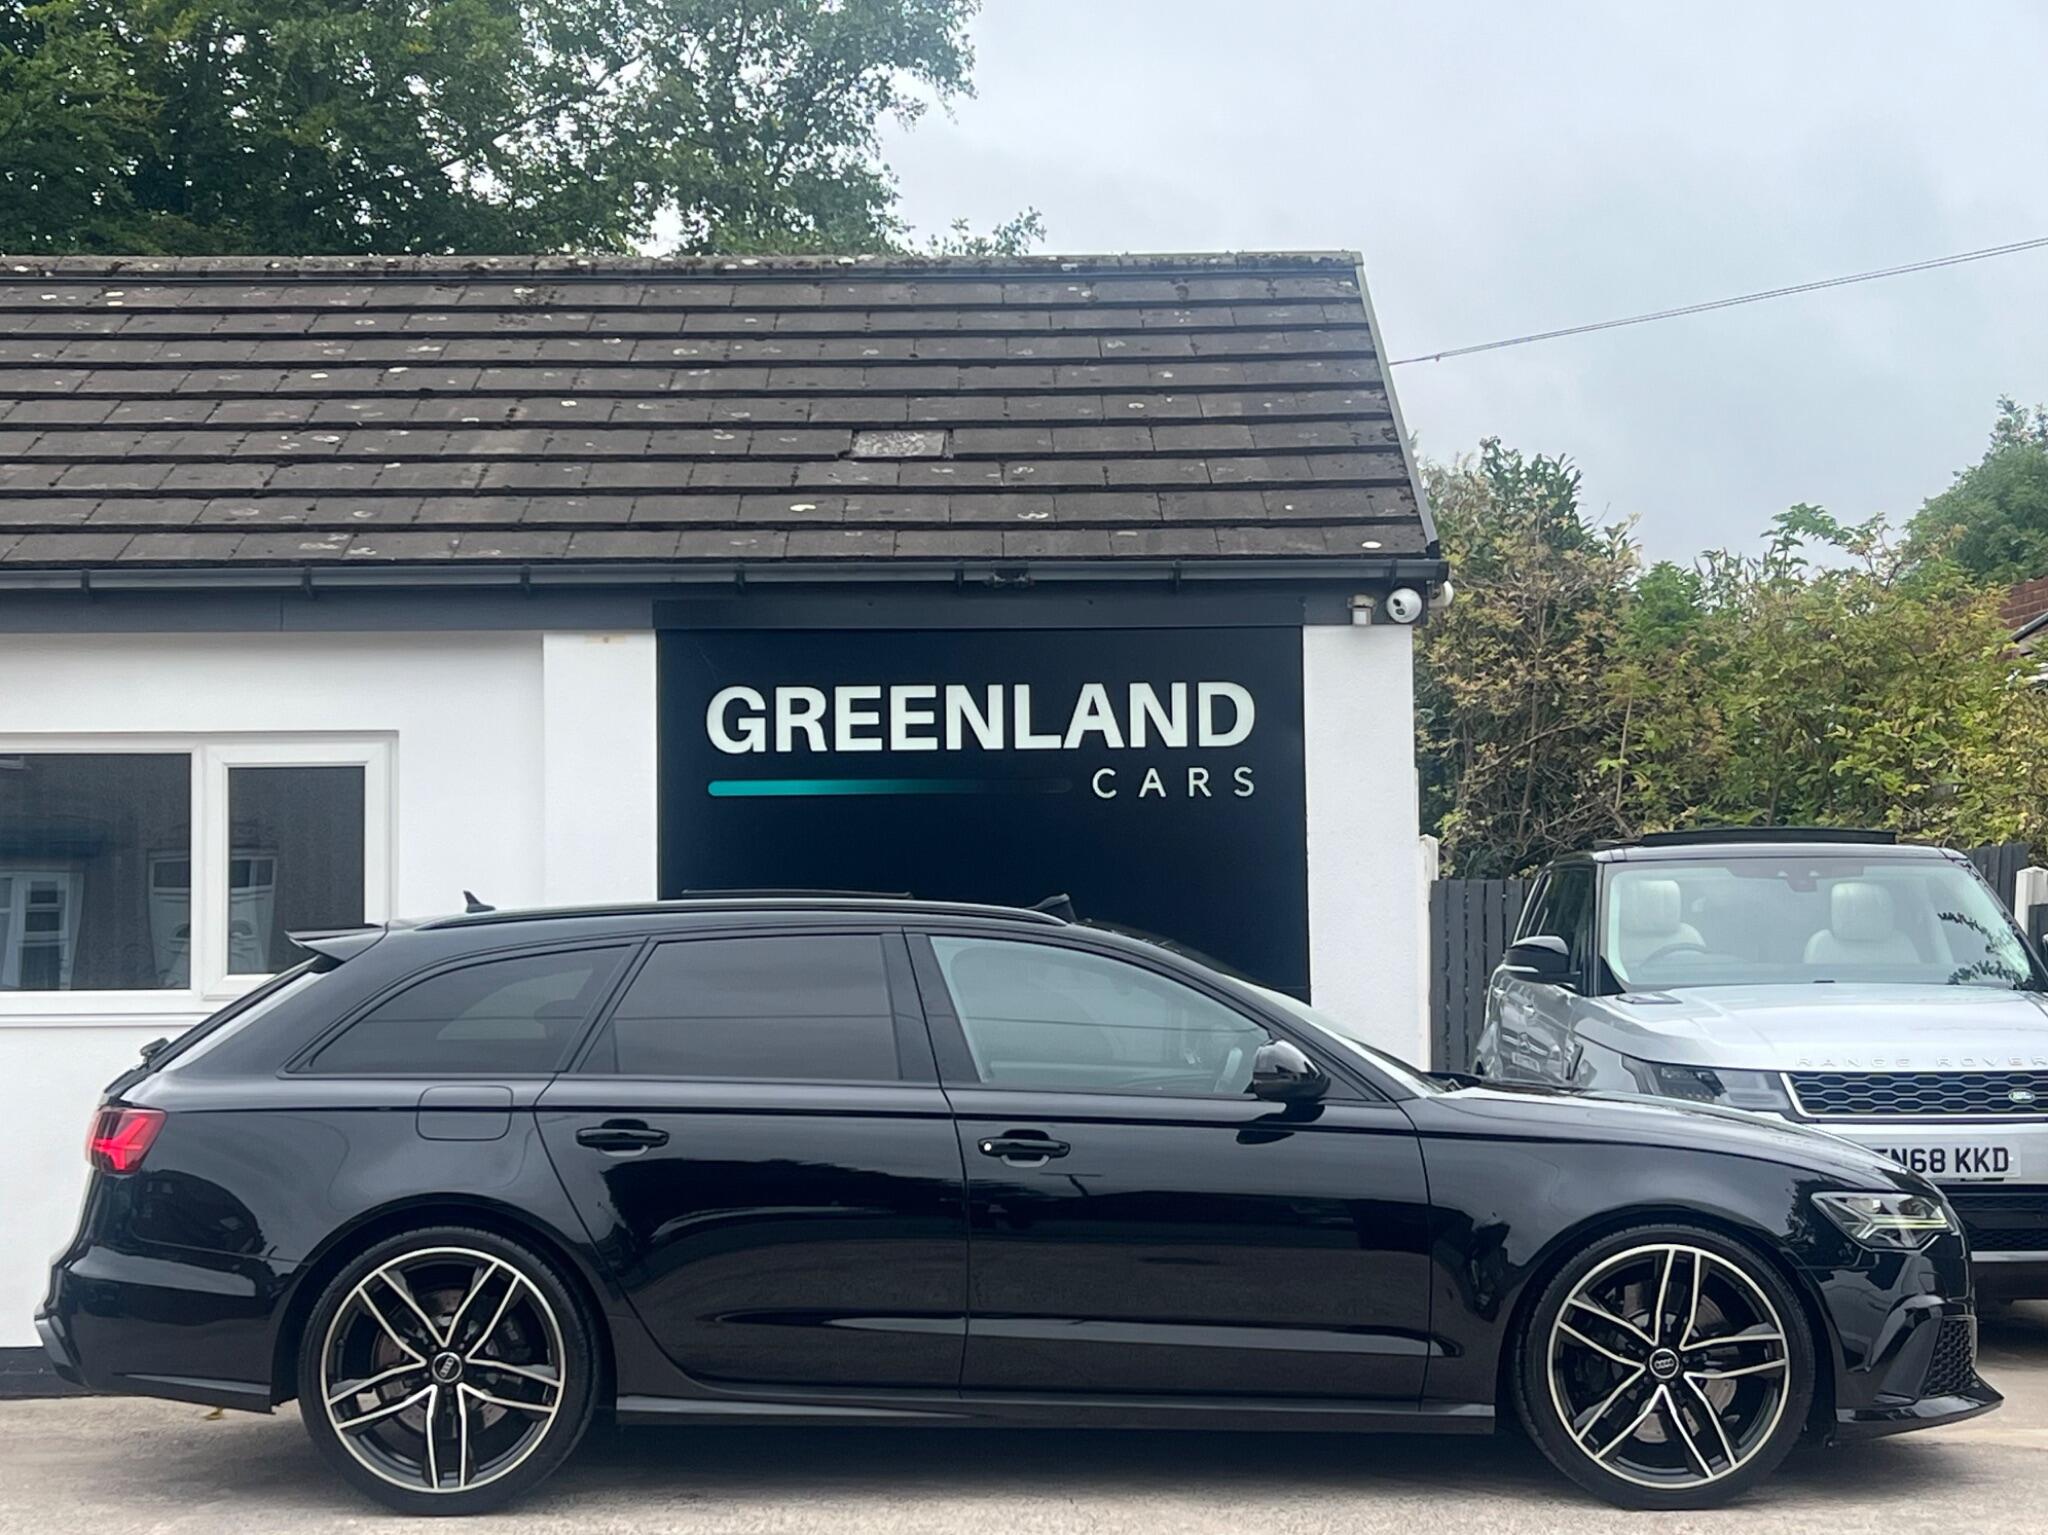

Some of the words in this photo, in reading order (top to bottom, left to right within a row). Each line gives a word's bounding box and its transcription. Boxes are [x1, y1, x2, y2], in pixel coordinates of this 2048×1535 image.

[706, 682, 1255, 754] GREENLAND
[1092, 766, 1255, 798] CARS
[1796, 1057, 1911, 1068] RANGE
[1936, 1056, 2048, 1067] ROVER
[1873, 1148, 1946, 1173] N68
[1955, 1147, 2009, 1173] KKD
